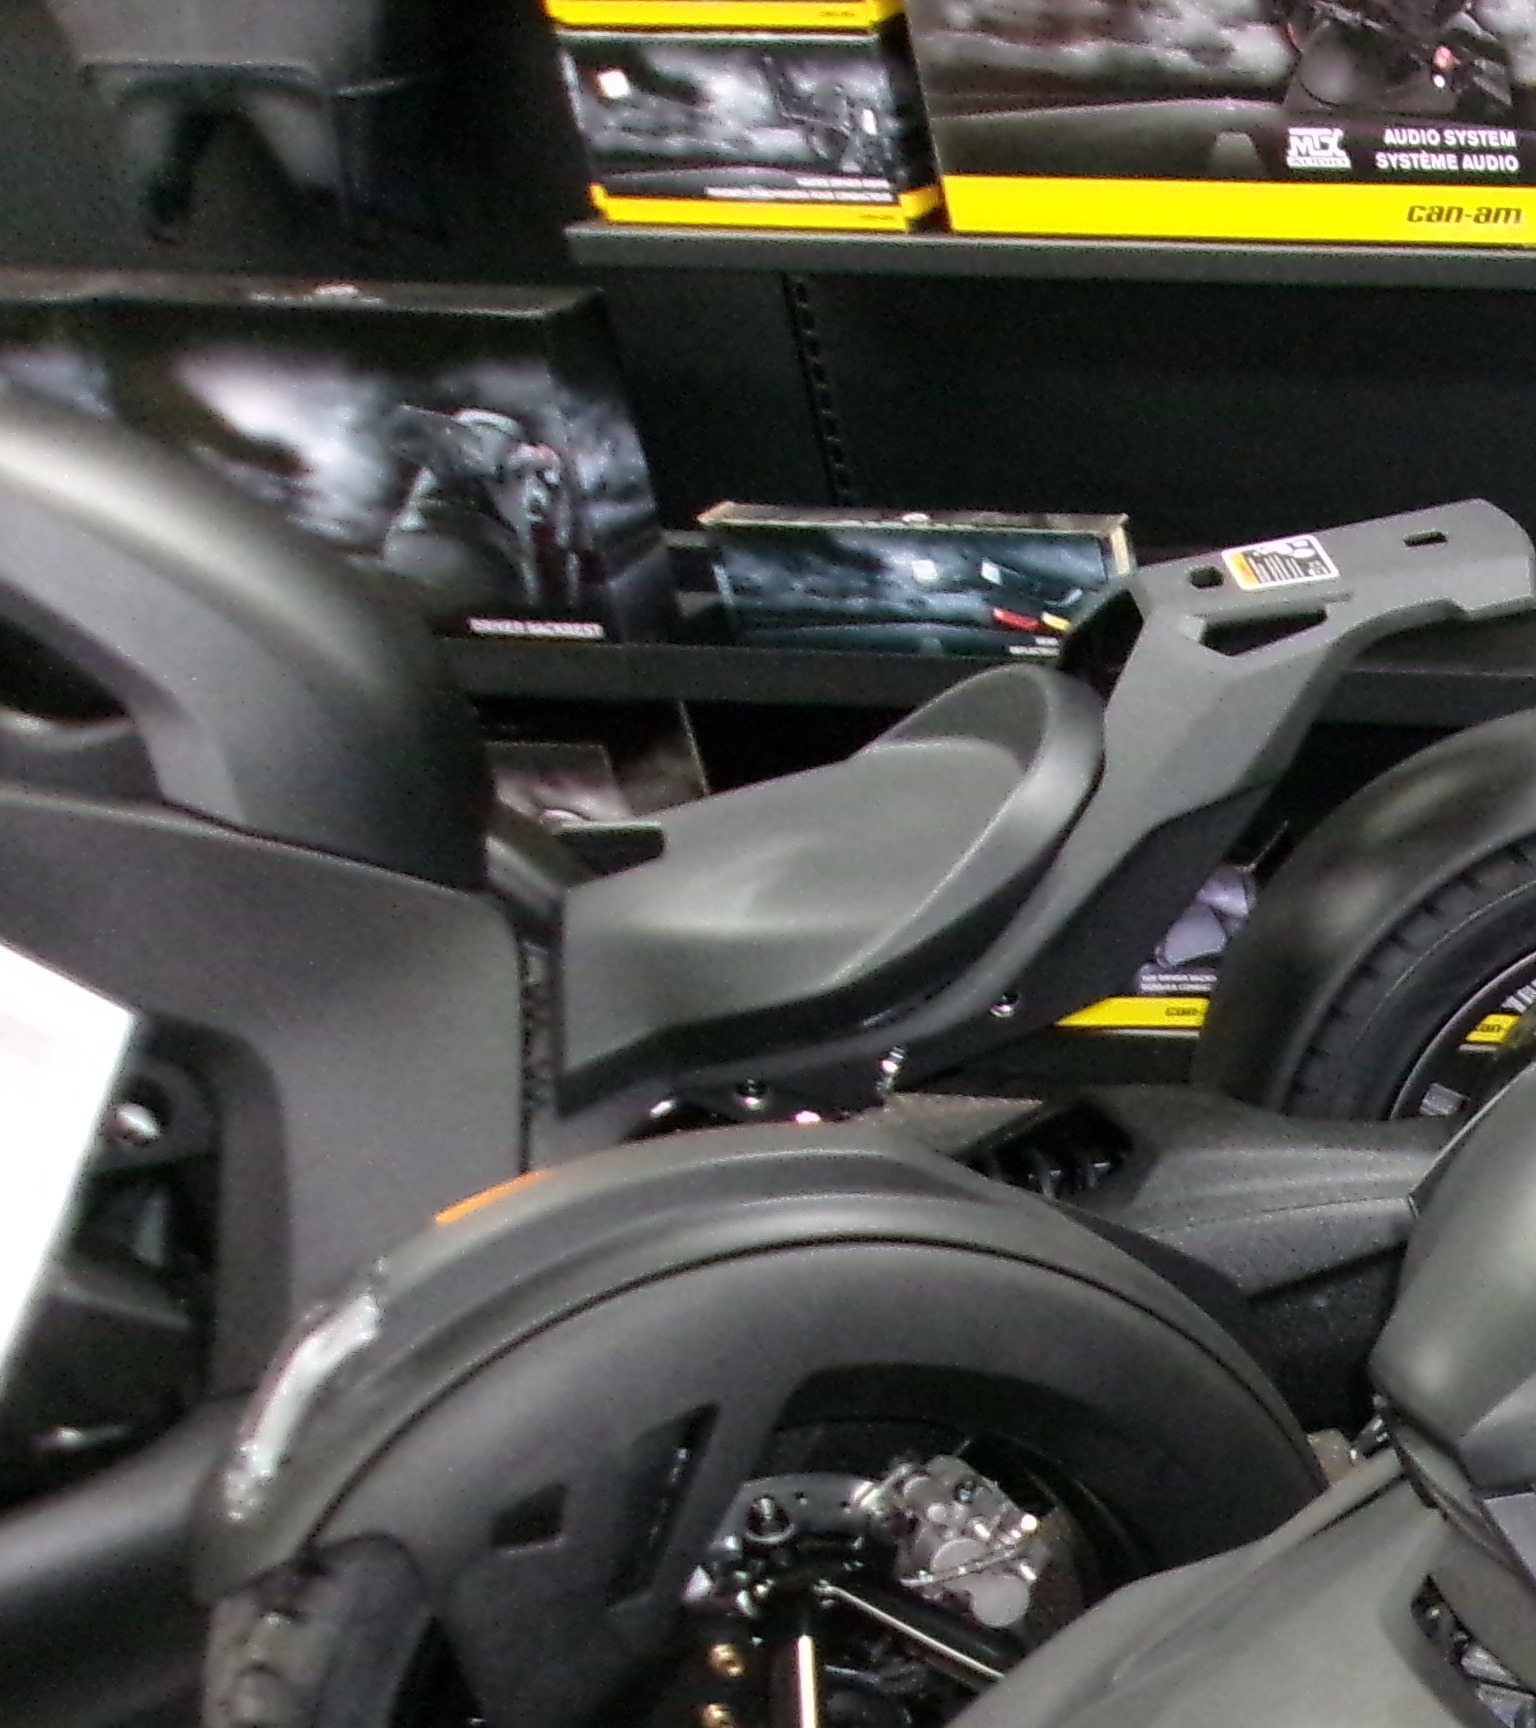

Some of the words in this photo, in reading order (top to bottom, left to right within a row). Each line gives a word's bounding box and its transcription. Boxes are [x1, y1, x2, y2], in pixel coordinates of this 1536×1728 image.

[1384, 128, 1439, 146] AUDIO
[1443, 129, 1516, 147] SYSTEM
[1376, 149, 1459, 170] SYSTÈME
[1462, 153, 1520, 172] AUDIO
[1406, 204, 1522, 225] can-am
